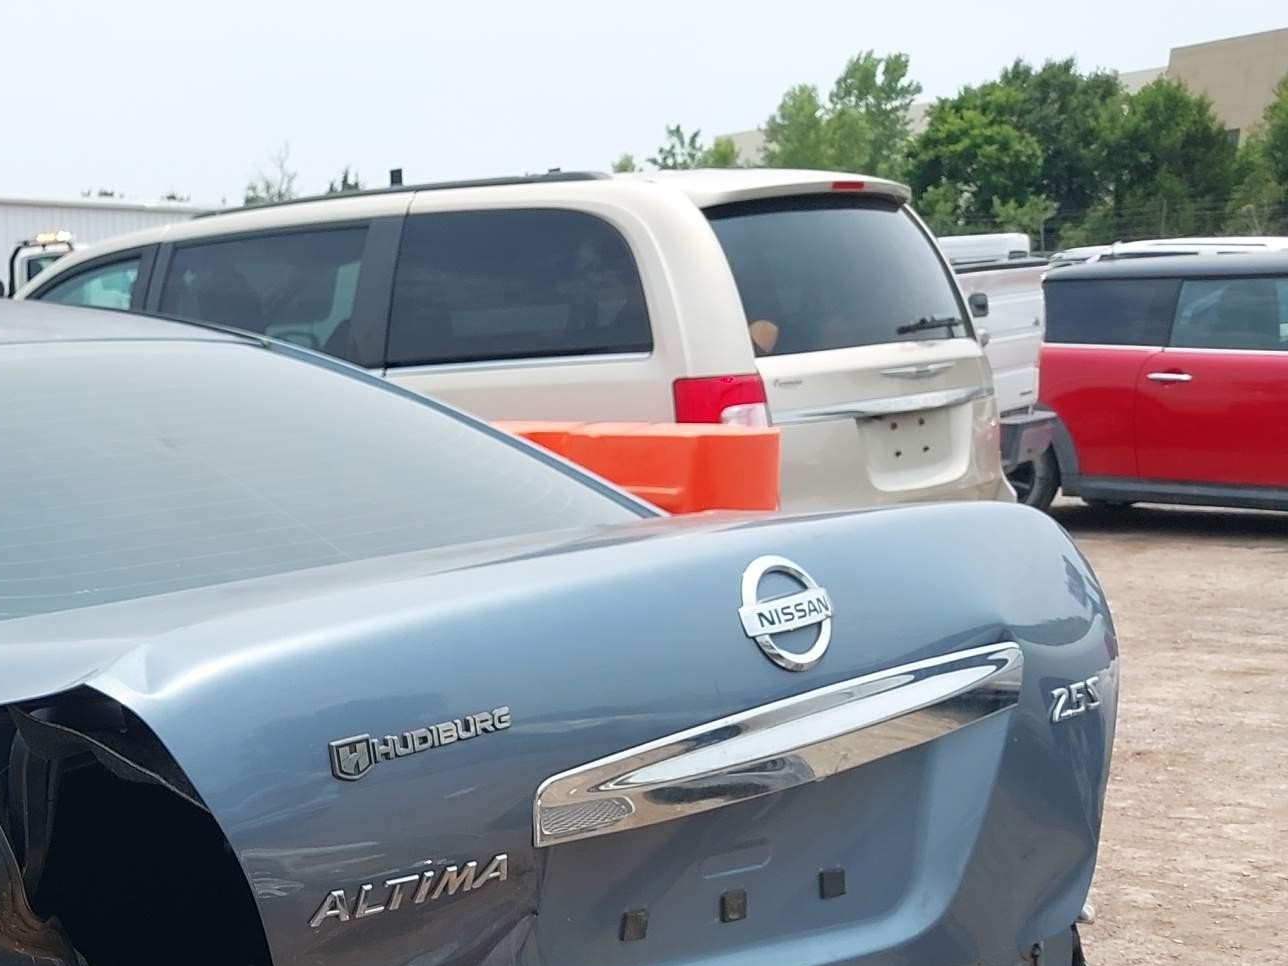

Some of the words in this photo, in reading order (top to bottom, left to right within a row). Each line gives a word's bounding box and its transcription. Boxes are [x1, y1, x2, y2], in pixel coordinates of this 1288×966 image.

[757, 595, 830, 628] NISSAN
[371, 705, 512, 763] HUDIBURG
[308, 853, 508, 928] ALTIMA
